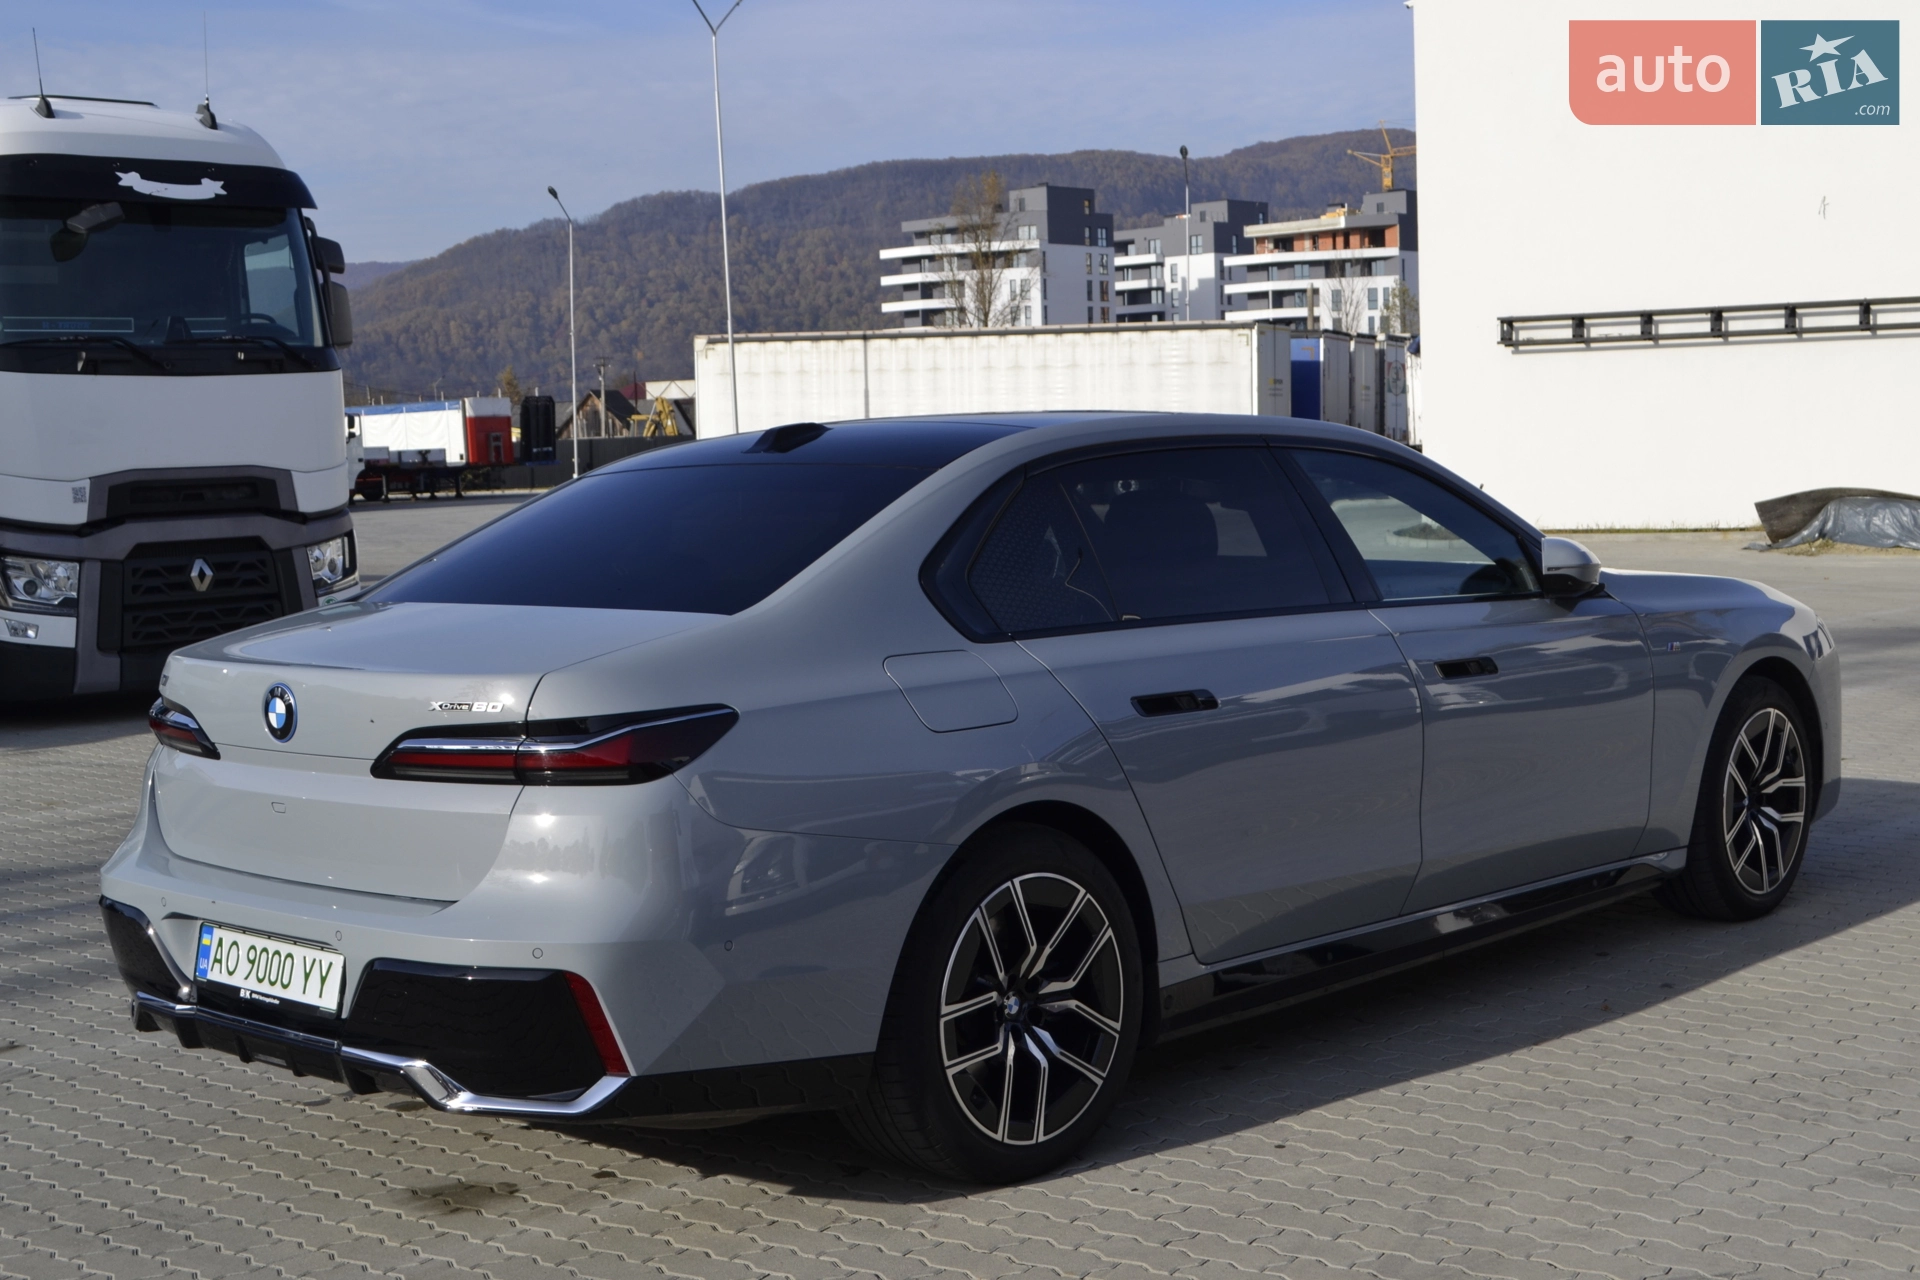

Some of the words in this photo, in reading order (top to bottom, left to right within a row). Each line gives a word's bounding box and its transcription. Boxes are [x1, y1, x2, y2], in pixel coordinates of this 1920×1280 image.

[199, 957, 208, 970] UA
[210, 937, 240, 977] AO
[244, 945, 294, 990] 9000
[303, 956, 333, 999] YY
